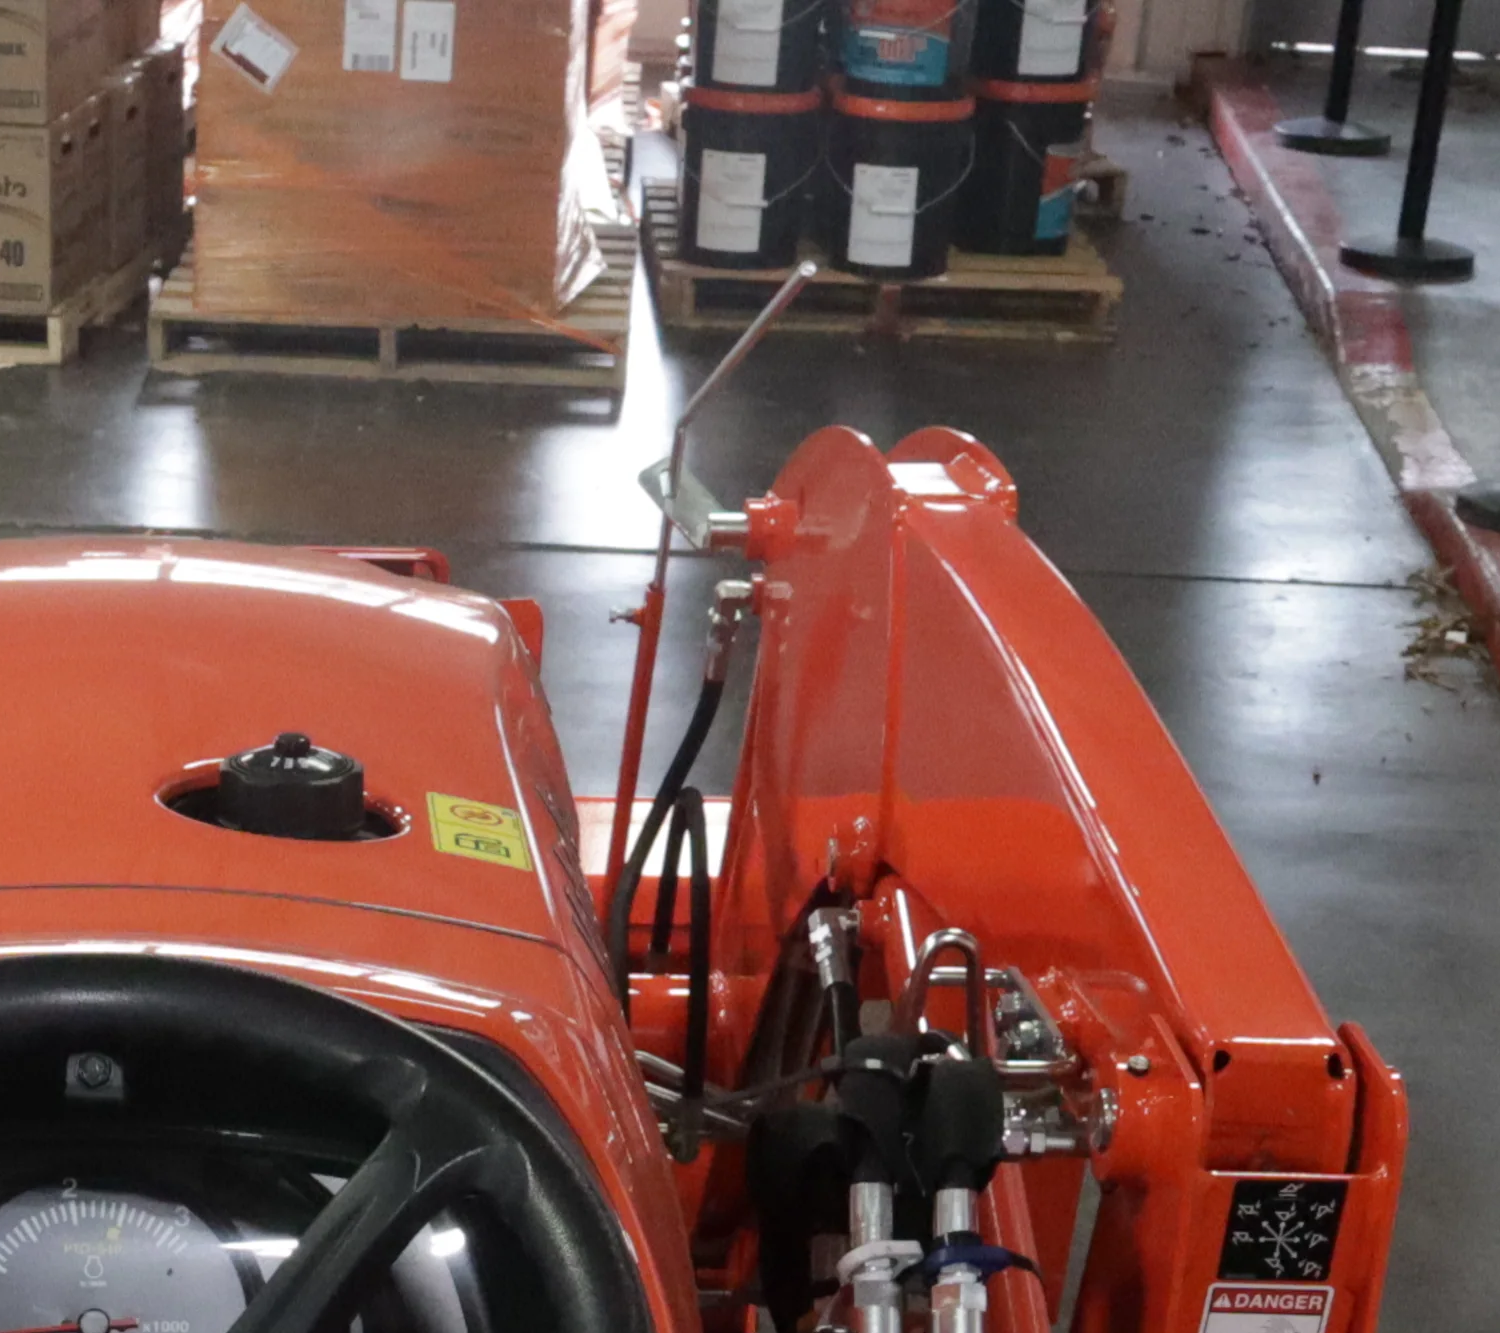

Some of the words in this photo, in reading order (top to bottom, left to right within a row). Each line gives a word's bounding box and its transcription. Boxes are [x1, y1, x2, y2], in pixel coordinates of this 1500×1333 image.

[61, 1178, 78, 1198] 2
[174, 1205, 192, 1228] 3
[1232, 1294, 1324, 1311] DANGER
